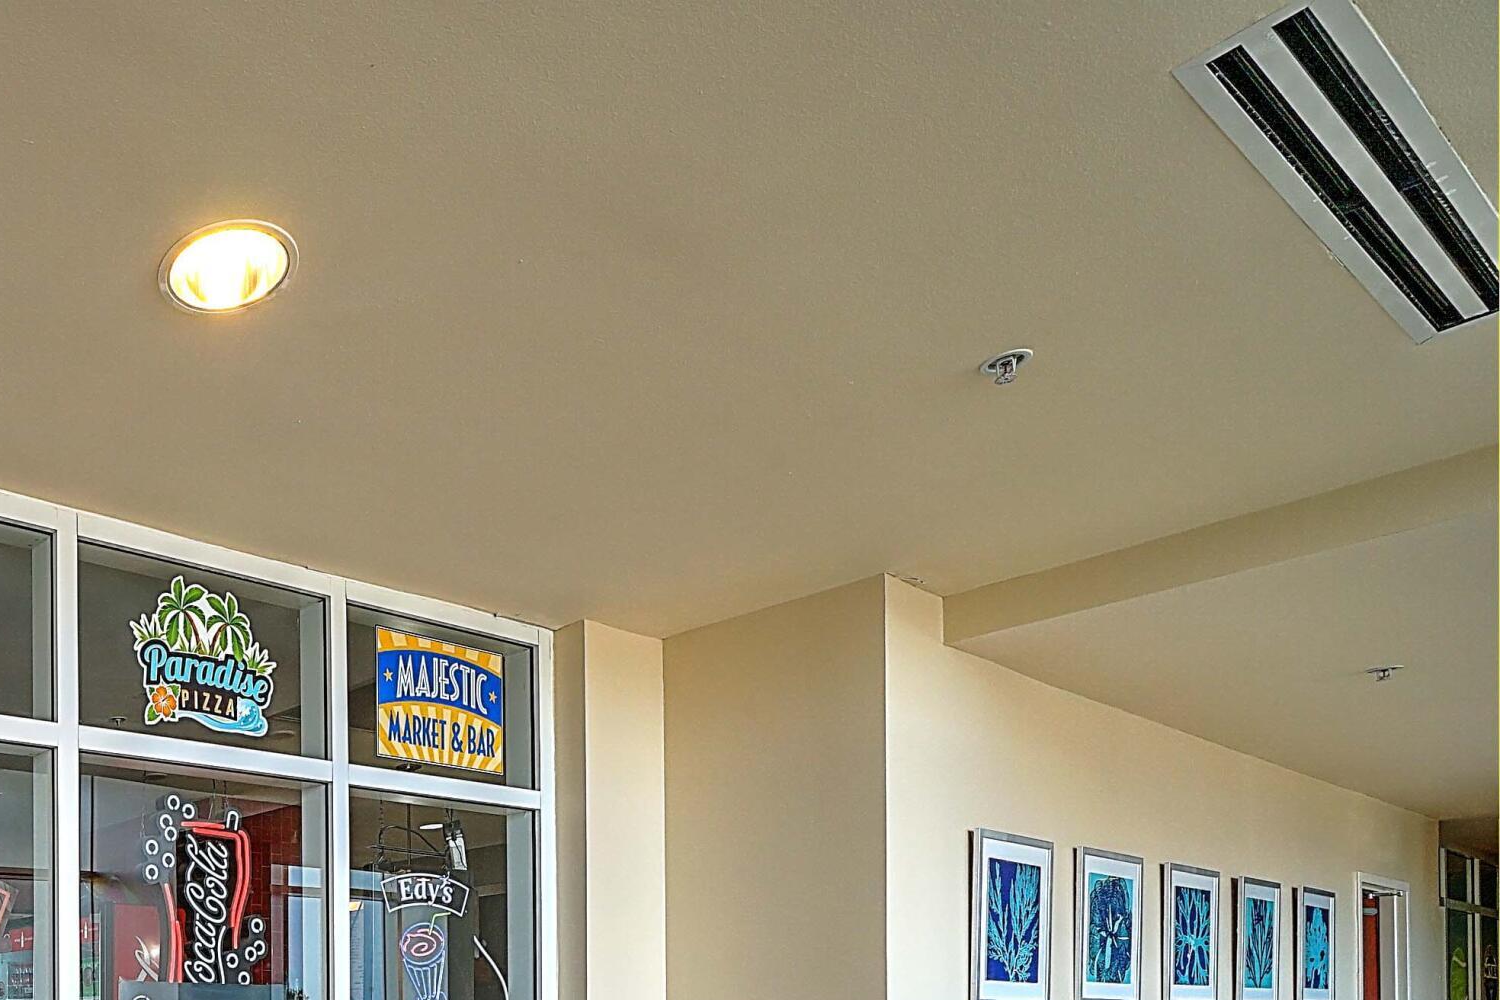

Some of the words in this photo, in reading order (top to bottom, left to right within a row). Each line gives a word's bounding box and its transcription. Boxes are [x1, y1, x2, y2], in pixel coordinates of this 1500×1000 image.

[143, 644, 269, 701] Paradise
[396, 654, 488, 715] MAJESTIC
[181, 688, 235, 718] PIZZA
[388, 710, 446, 750] MARKET
[451, 722, 463, 753] &
[467, 724, 495, 758] BAR
[399, 877, 454, 905] Edy's
